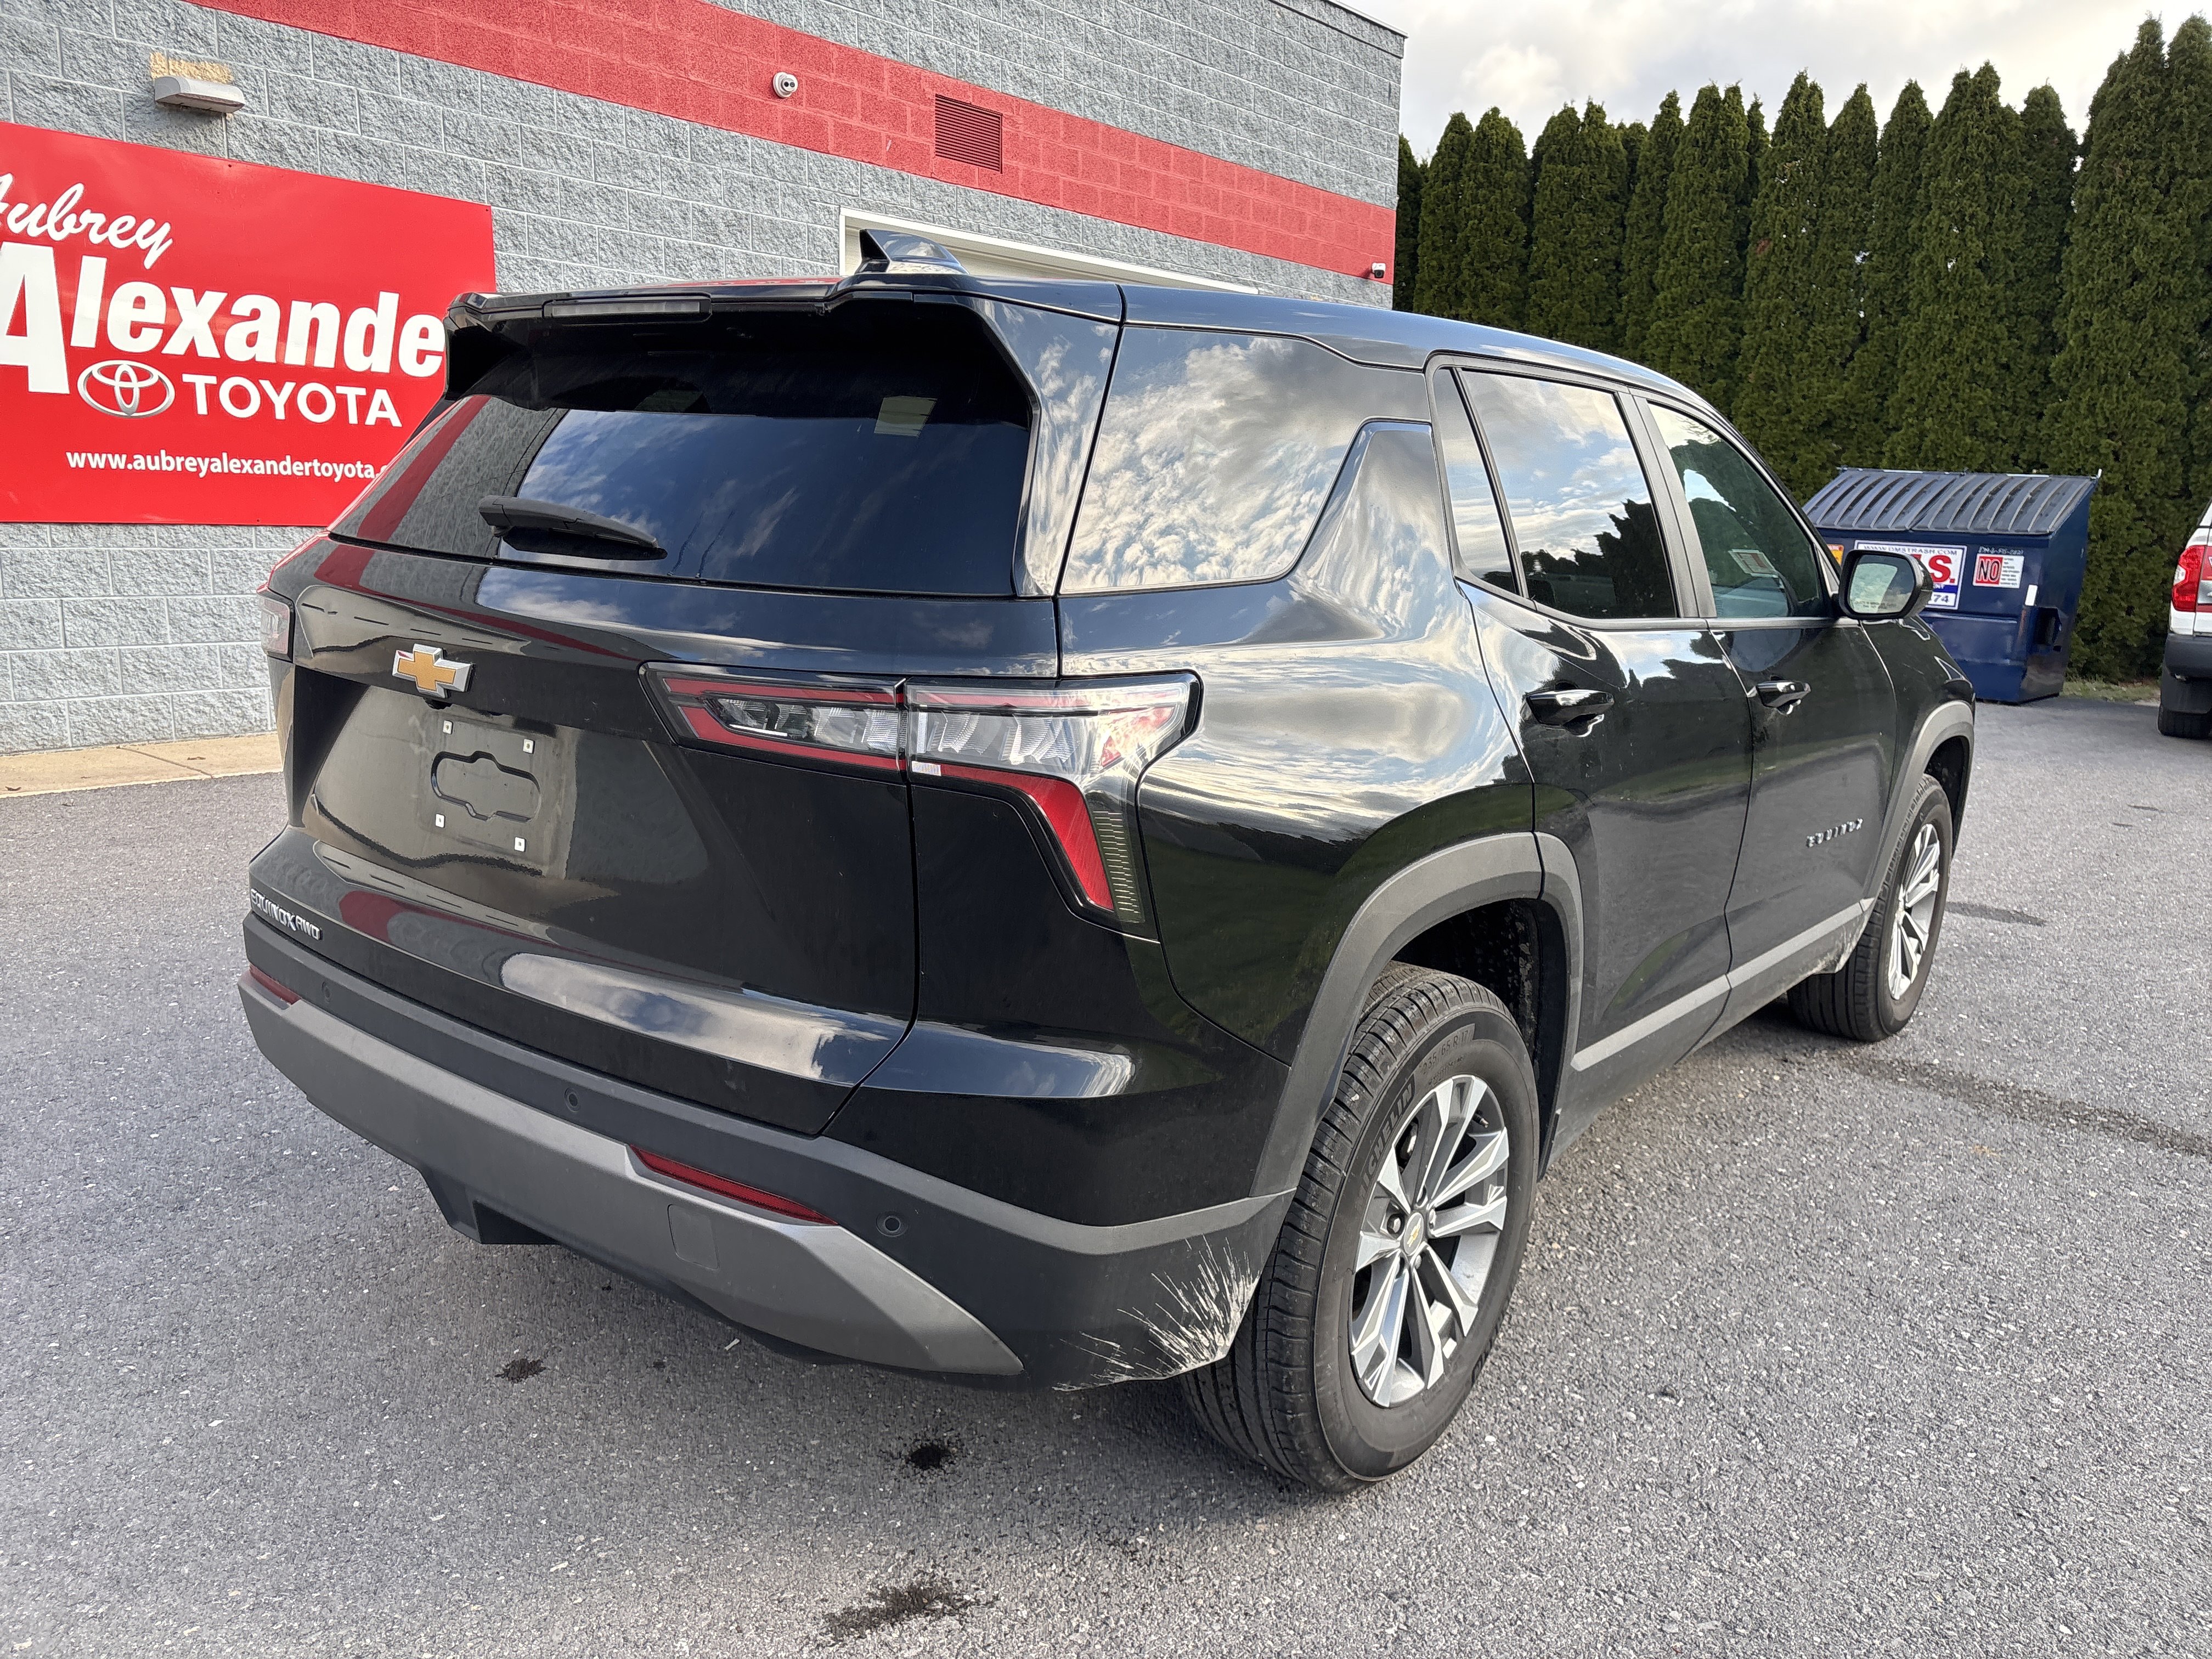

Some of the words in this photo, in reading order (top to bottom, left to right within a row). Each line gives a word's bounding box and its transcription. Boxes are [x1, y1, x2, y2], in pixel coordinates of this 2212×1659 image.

[0, 172, 173, 270] ubrey
[182, 373, 403, 427] TOYOTA
[1977, 558, 2001, 582] NO
[251, 888, 296, 931] EQUINOX
[295, 915, 320, 940] AWD
